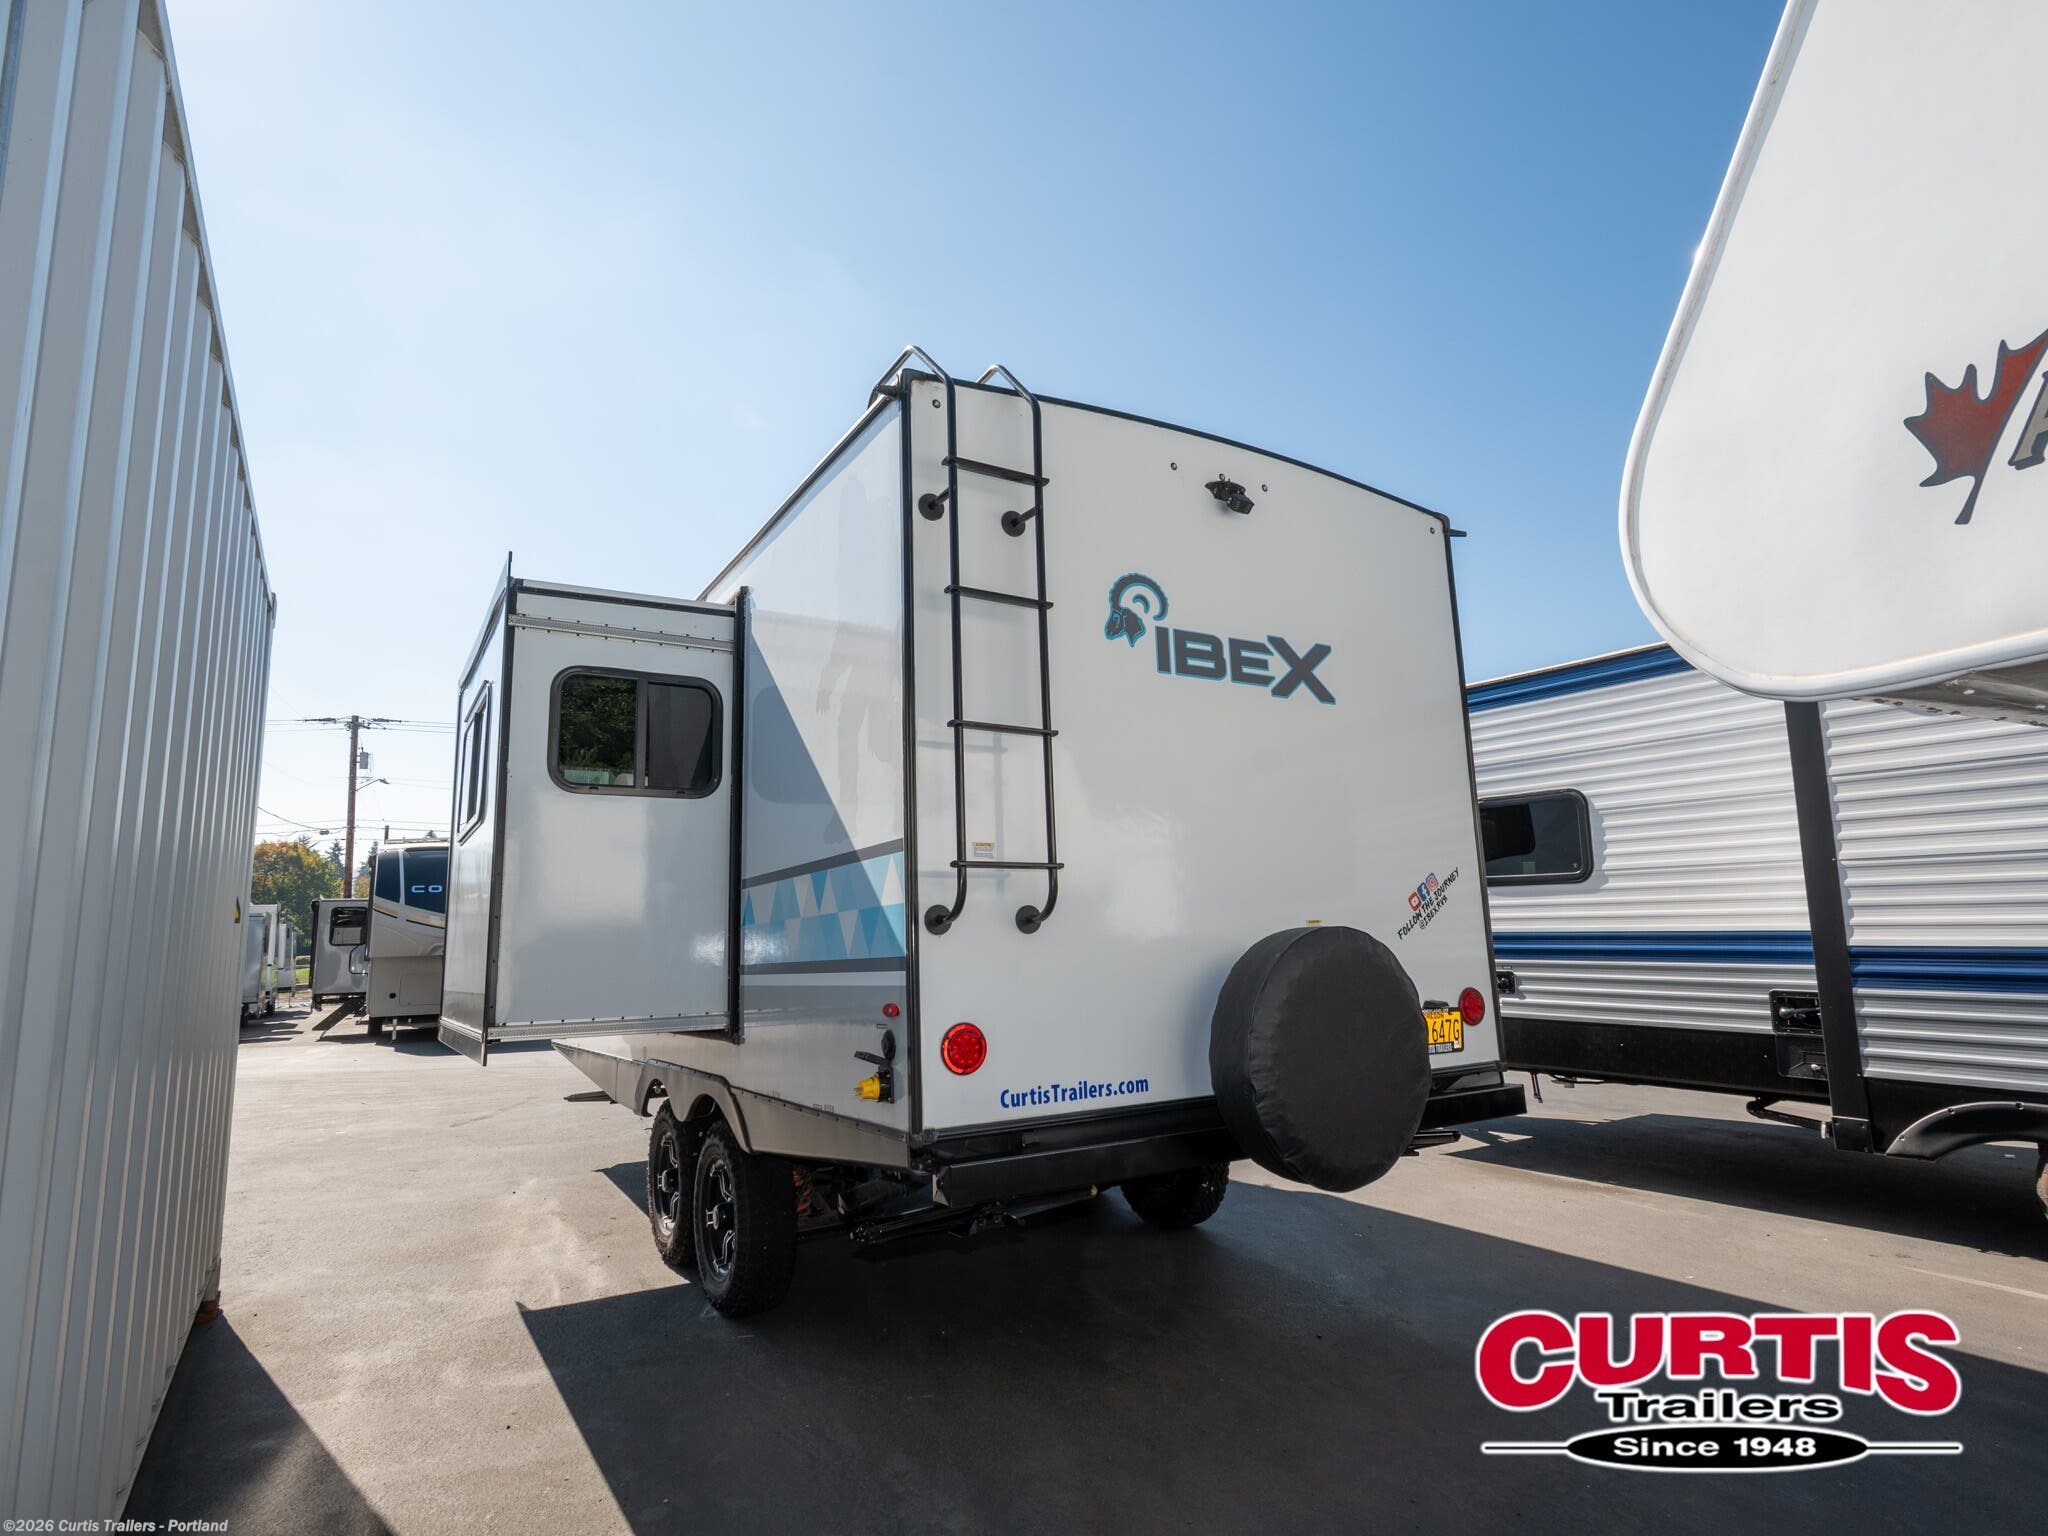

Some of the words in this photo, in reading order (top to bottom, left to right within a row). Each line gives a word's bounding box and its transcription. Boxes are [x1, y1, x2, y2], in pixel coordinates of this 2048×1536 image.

[1155, 625, 1336, 705] IBEX
[1397, 909, 1422, 940] FOLLOW
[1421, 896, 1434, 913] THE
[1433, 866, 1459, 901] JOURNEY
[1000, 1078, 1149, 1108] CurtisTrailers.com
